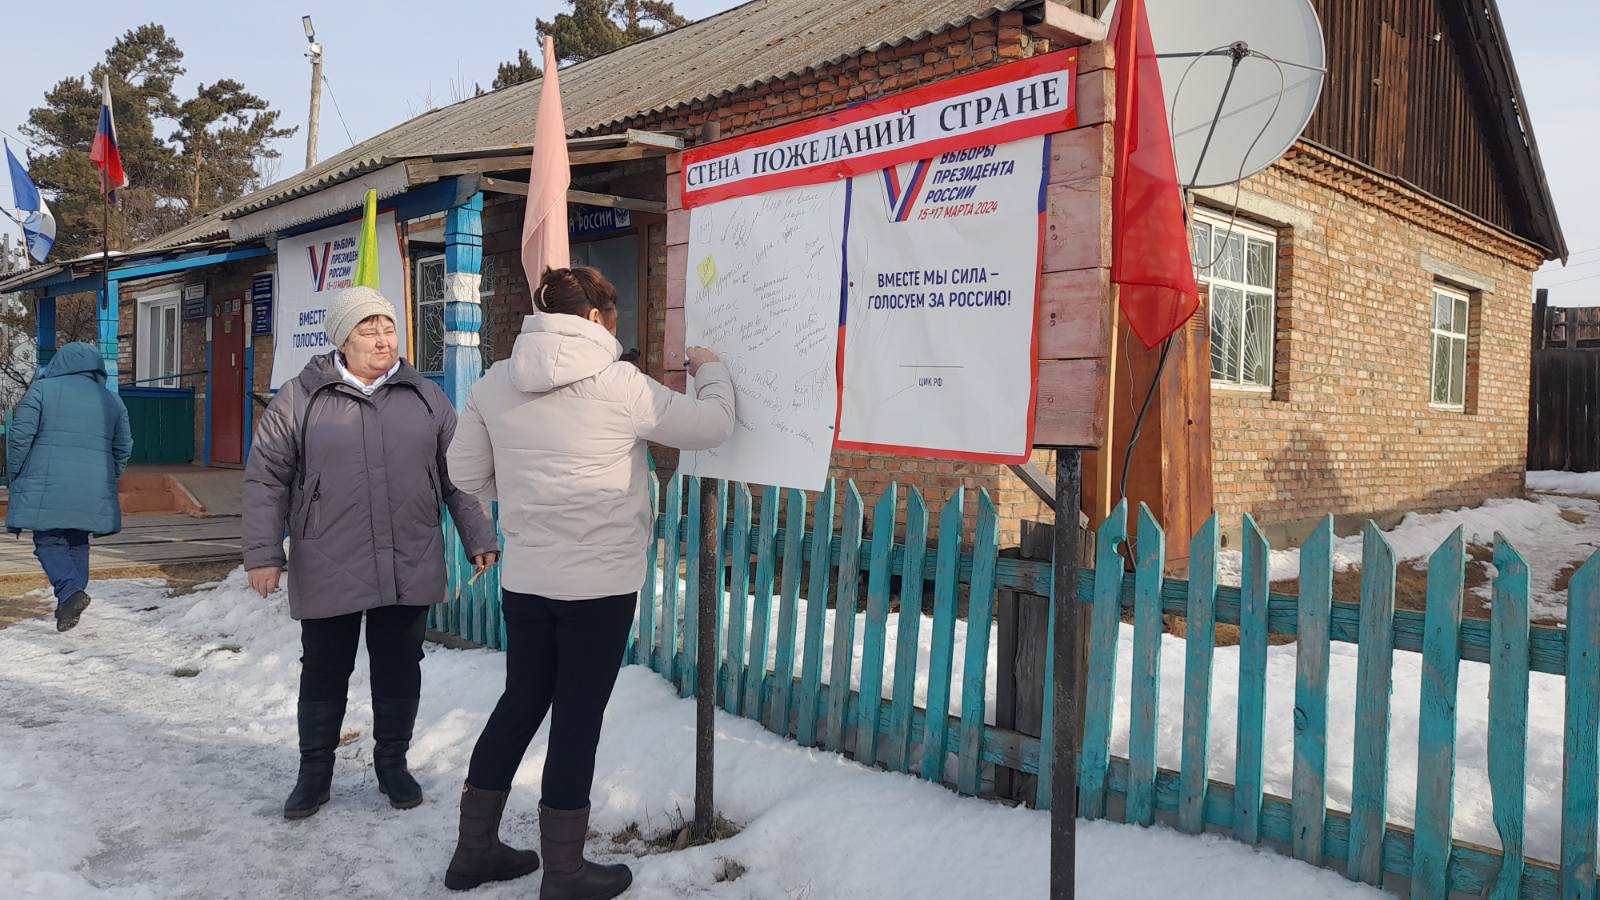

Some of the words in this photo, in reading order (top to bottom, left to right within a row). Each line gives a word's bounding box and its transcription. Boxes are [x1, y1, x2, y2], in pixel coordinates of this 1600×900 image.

[687, 157, 740, 186] СТЕНА
[752, 108, 916, 175] ПОЖЕЛАНИЙ
[939, 77, 1060, 131] СТРАНЕ
[940, 144, 997, 165] ВЫБОРЫ
[932, 160, 1015, 184] ПРЕЗИДЕНТА
[925, 185, 977, 204] РОССИИ
[944, 203, 974, 218] МАРТА
[975, 201, 998, 215] 2024
[579, 210, 612, 230] РОССИИ
[333, 237, 356, 250] ВЫБОРЫ
[331, 251, 358, 264] ПРЕЗИДЕН
[329, 266, 351, 278] РОССИИ
[877, 271, 920, 288] ВМЕСТЕ
[923, 269, 948, 286] МЫ
[951, 267, 987, 284] СИЛА
[868, 293, 925, 310] ГОЛОСУЕМ
[928, 292, 945, 308] ЗА
[949, 290, 1012, 307] РОССИЮ!
[292, 331, 330, 348] ГОЛОСУЕМ
[919, 377, 932, 387] ЦИК
[934, 377, 943, 387] РФ
